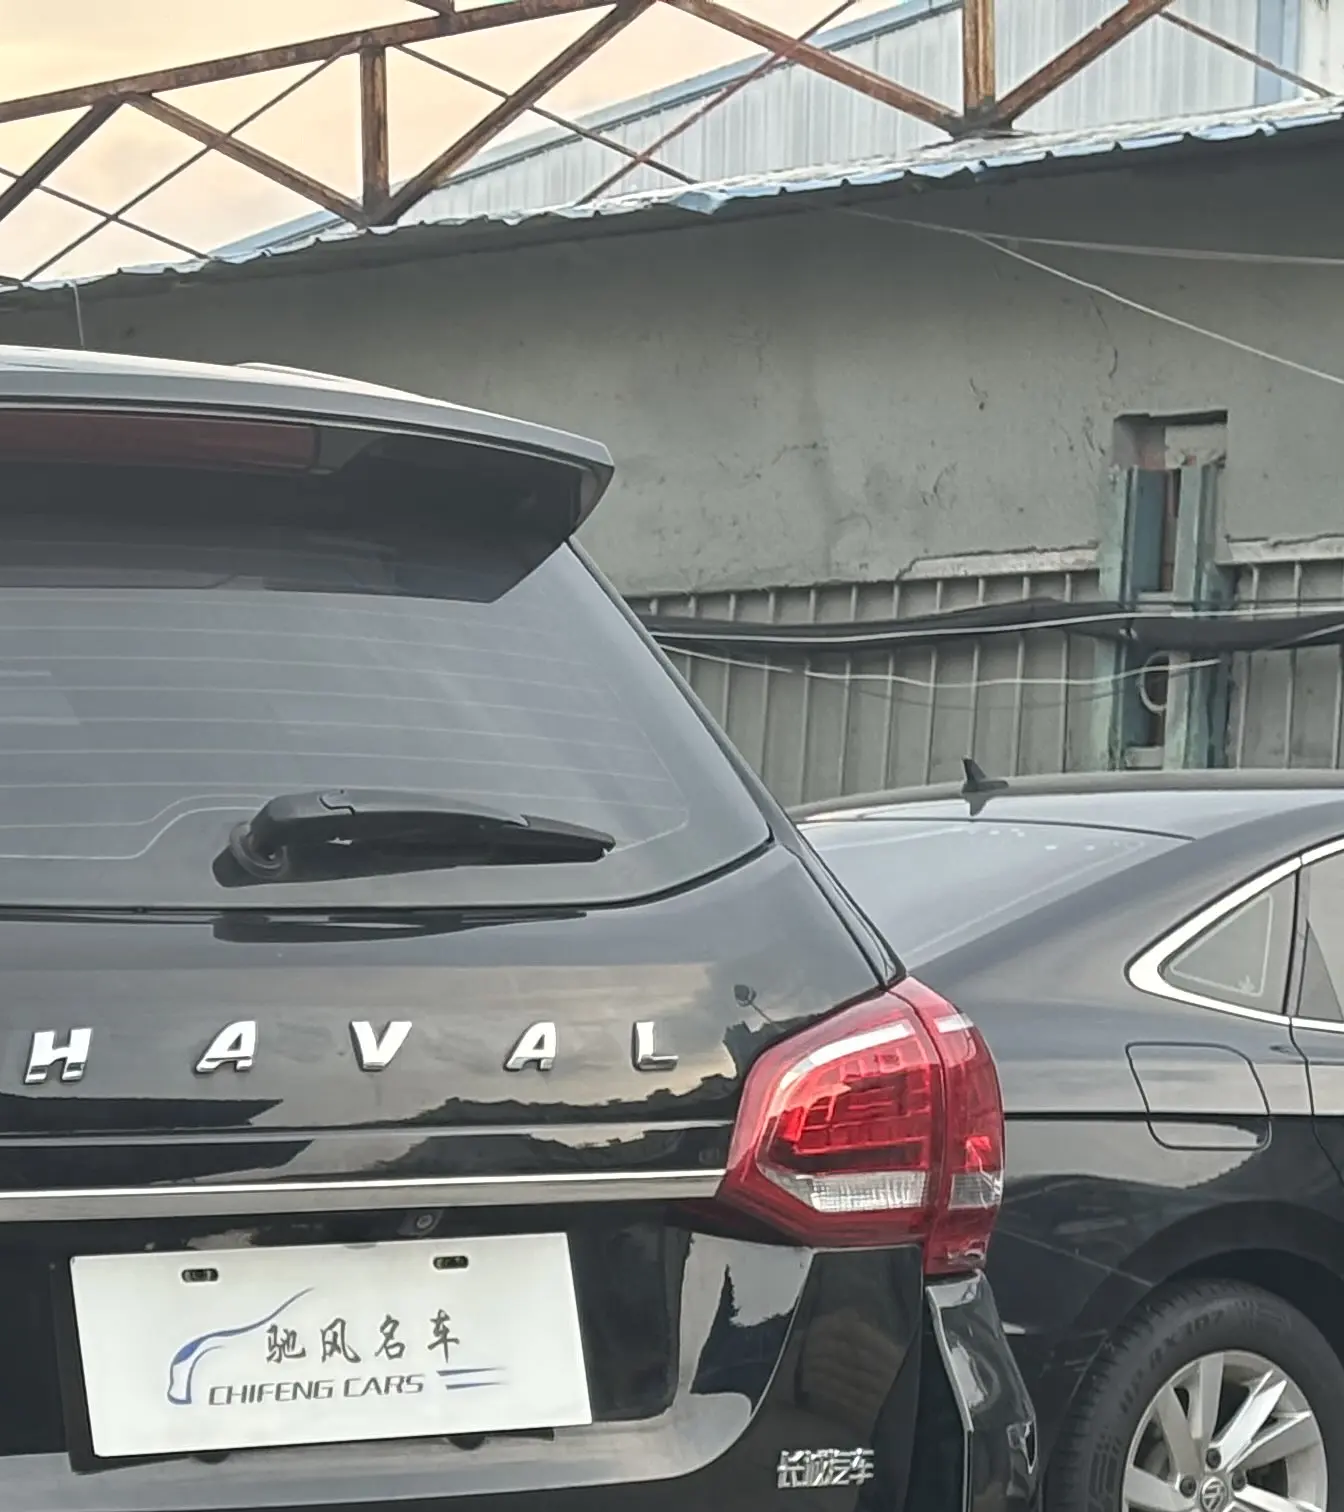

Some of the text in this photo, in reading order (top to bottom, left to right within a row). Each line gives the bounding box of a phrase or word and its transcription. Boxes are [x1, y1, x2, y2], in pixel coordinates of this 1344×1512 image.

[23, 1021, 678, 1083] HAVAL
[265, 1308, 461, 1364] 驰风名车
[208, 1373, 425, 1406] CHIFENG CARS
